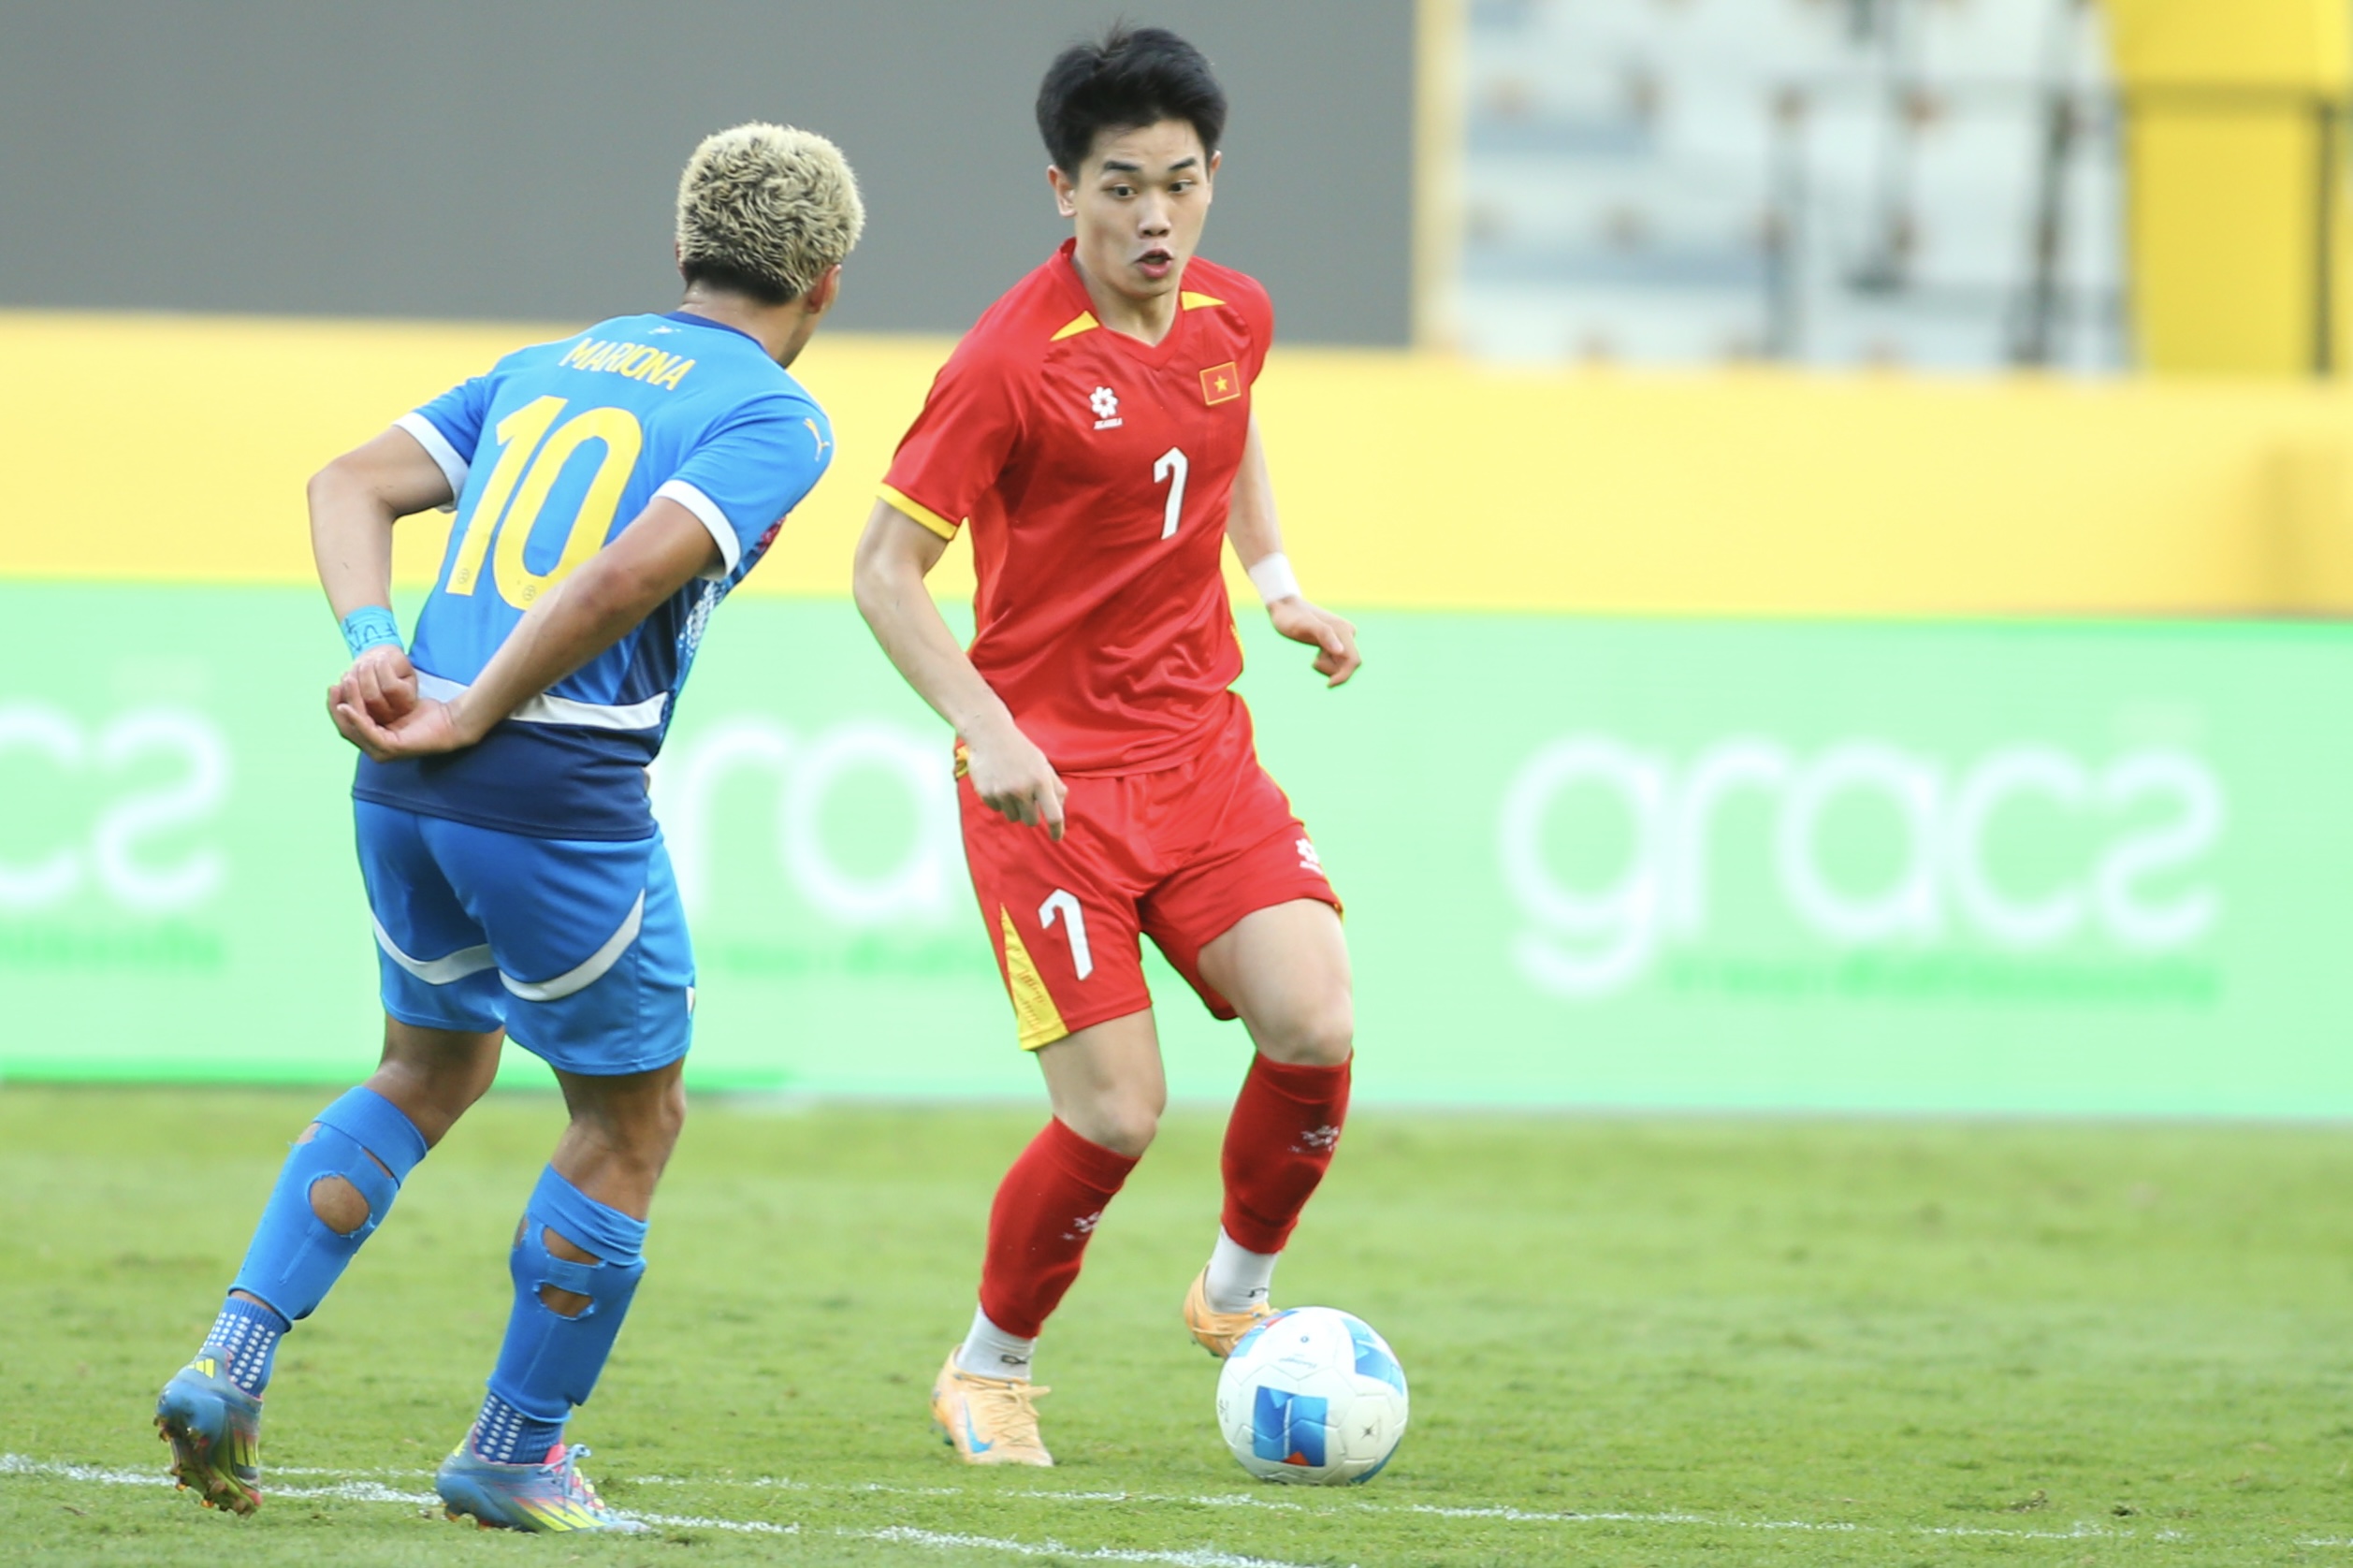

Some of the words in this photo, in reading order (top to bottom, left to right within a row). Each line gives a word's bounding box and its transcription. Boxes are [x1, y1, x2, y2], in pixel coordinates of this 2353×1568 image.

[558, 337, 697, 391] MARIONA
[445, 395, 644, 612] 10
[1153, 446, 1189, 541] 7
[1038, 888, 1094, 981] 7
